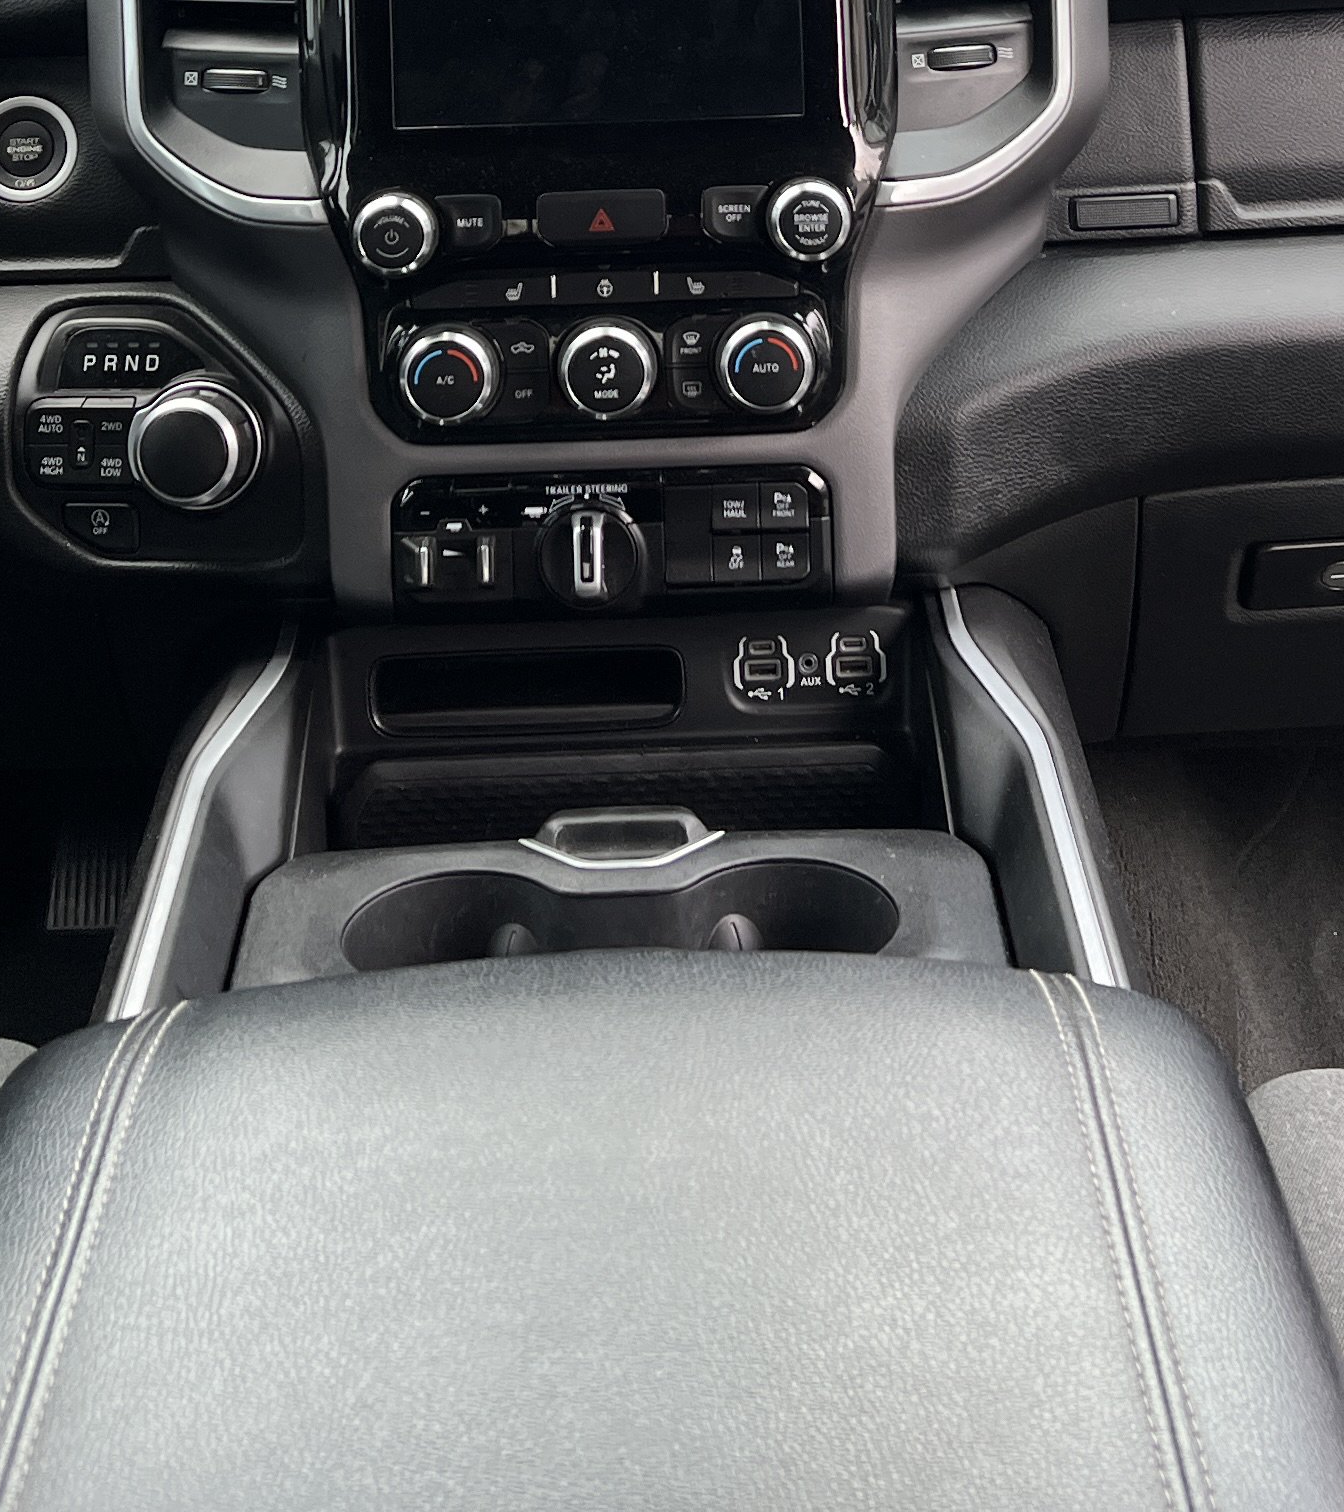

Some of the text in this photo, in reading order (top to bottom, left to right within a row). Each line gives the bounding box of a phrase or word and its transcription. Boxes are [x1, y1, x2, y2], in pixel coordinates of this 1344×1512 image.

[9, 137, 40, 146] START
[12, 153, 39, 162] STOP
[717, 204, 752, 214] SCREEN
[456, 217, 484, 228] MUTE
[725, 213, 743, 223] OFF
[798, 223, 826, 233] ENTER
[752, 362, 780, 374] AUTO
[435, 373, 455, 385] A/C
[514, 389, 533, 399] OFF
[594, 389, 620, 399] MODE
[39, 414, 62, 424] 4WD
[37, 424, 64, 434] AUTO
[100, 421, 123, 432] 2WD
[41, 456, 63, 465] 4WD
[100, 457, 123, 467] 4WD
[39, 465, 64, 475] HIGH
[100, 467, 122, 477] LOW
[545, 483, 628, 495] TRAILER STEERING
[92, 526, 109, 535] OFF
[800, 676, 822, 687] AUX
[865, 682, 875, 696] 2
[777, 688, 785, 701] 1
